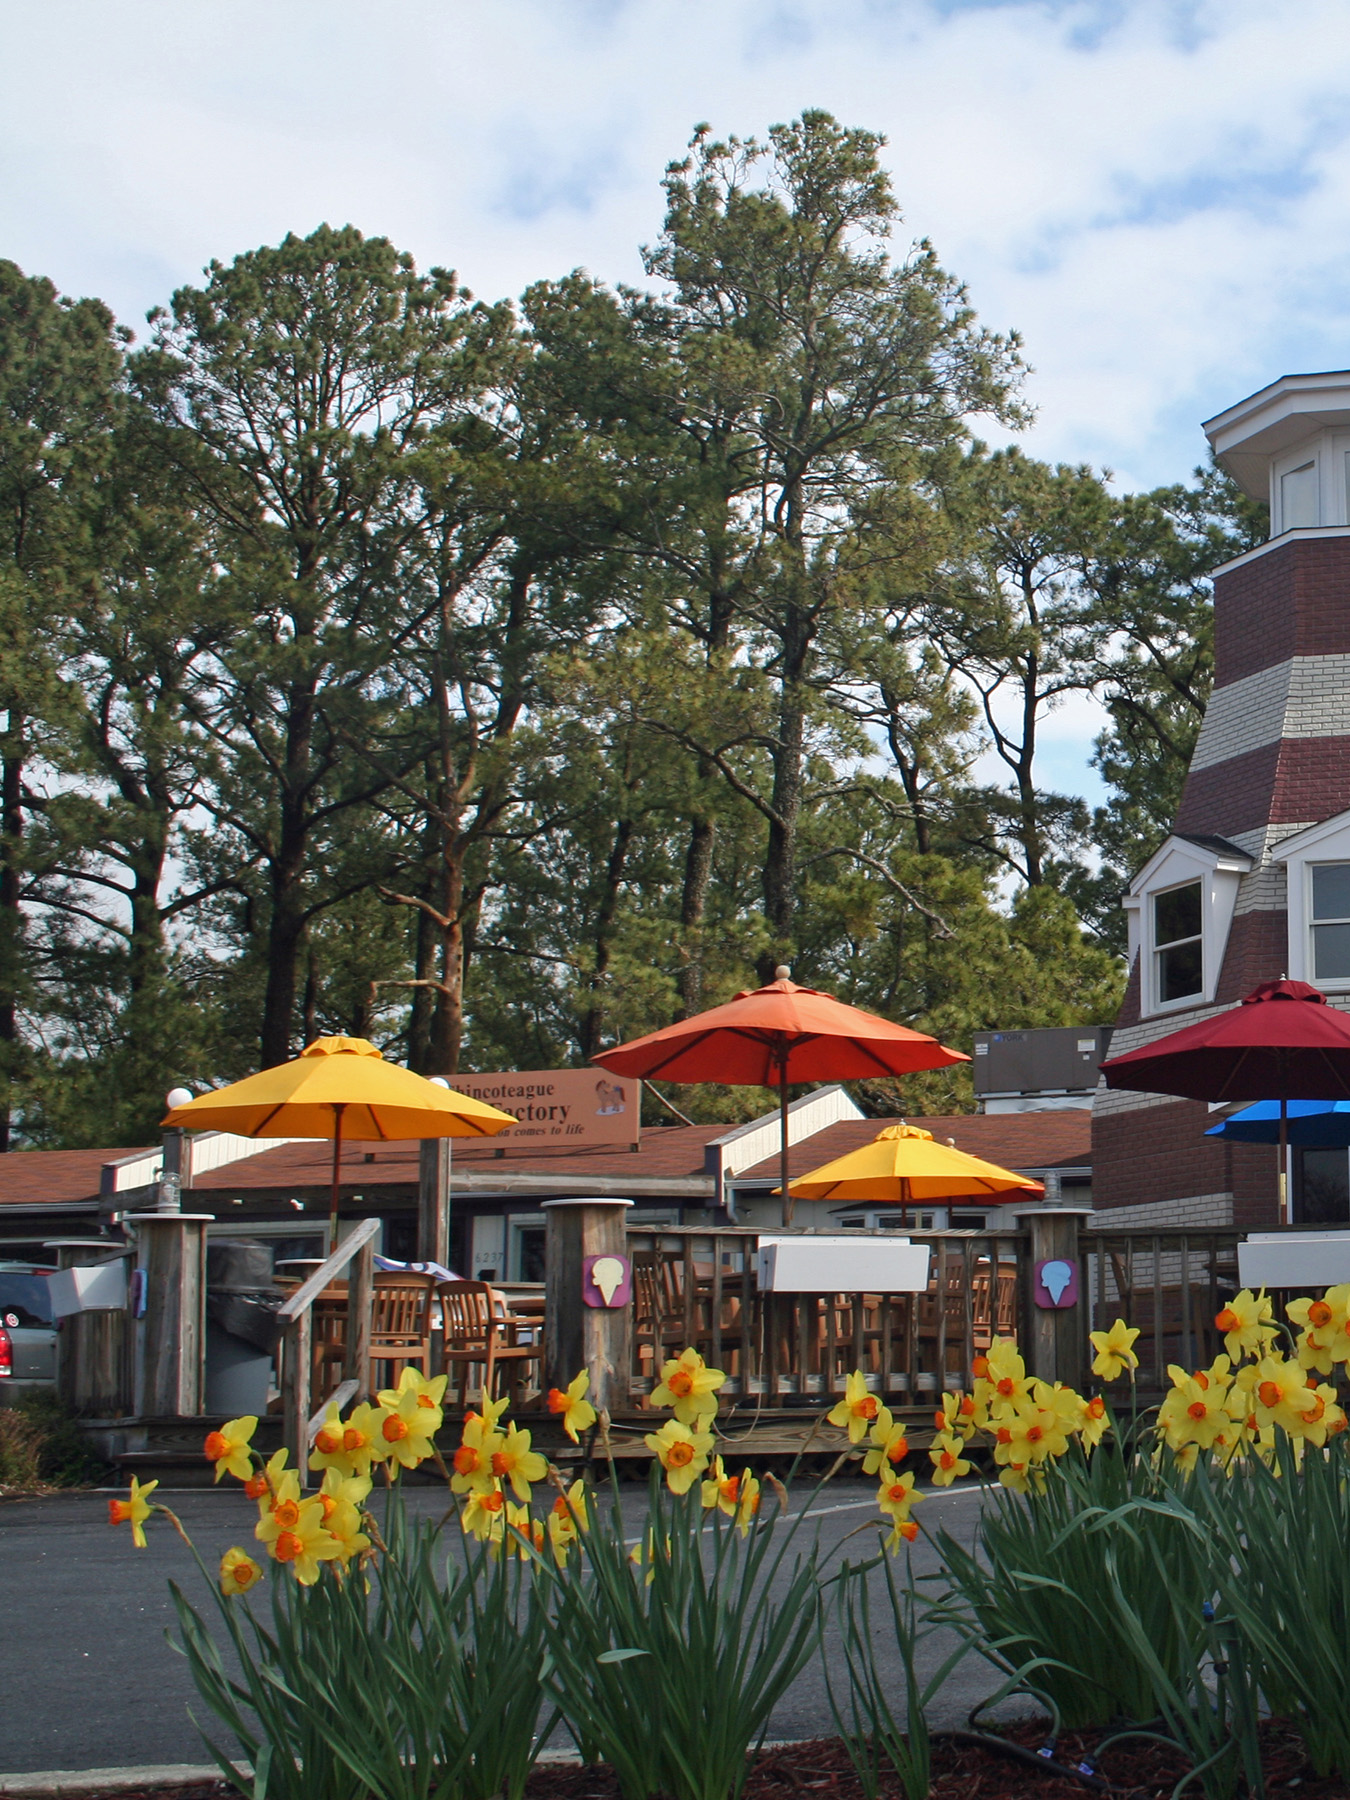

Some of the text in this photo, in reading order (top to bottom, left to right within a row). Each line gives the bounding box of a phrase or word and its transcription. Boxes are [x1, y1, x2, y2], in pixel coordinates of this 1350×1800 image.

[1003, 1033, 1024, 1041] YORK
[514, 1127, 546, 1136] comes
[551, 1126, 561, 1136] to
[566, 1124, 584, 1134] life
[475, 1252, 504, 1263] 6237
